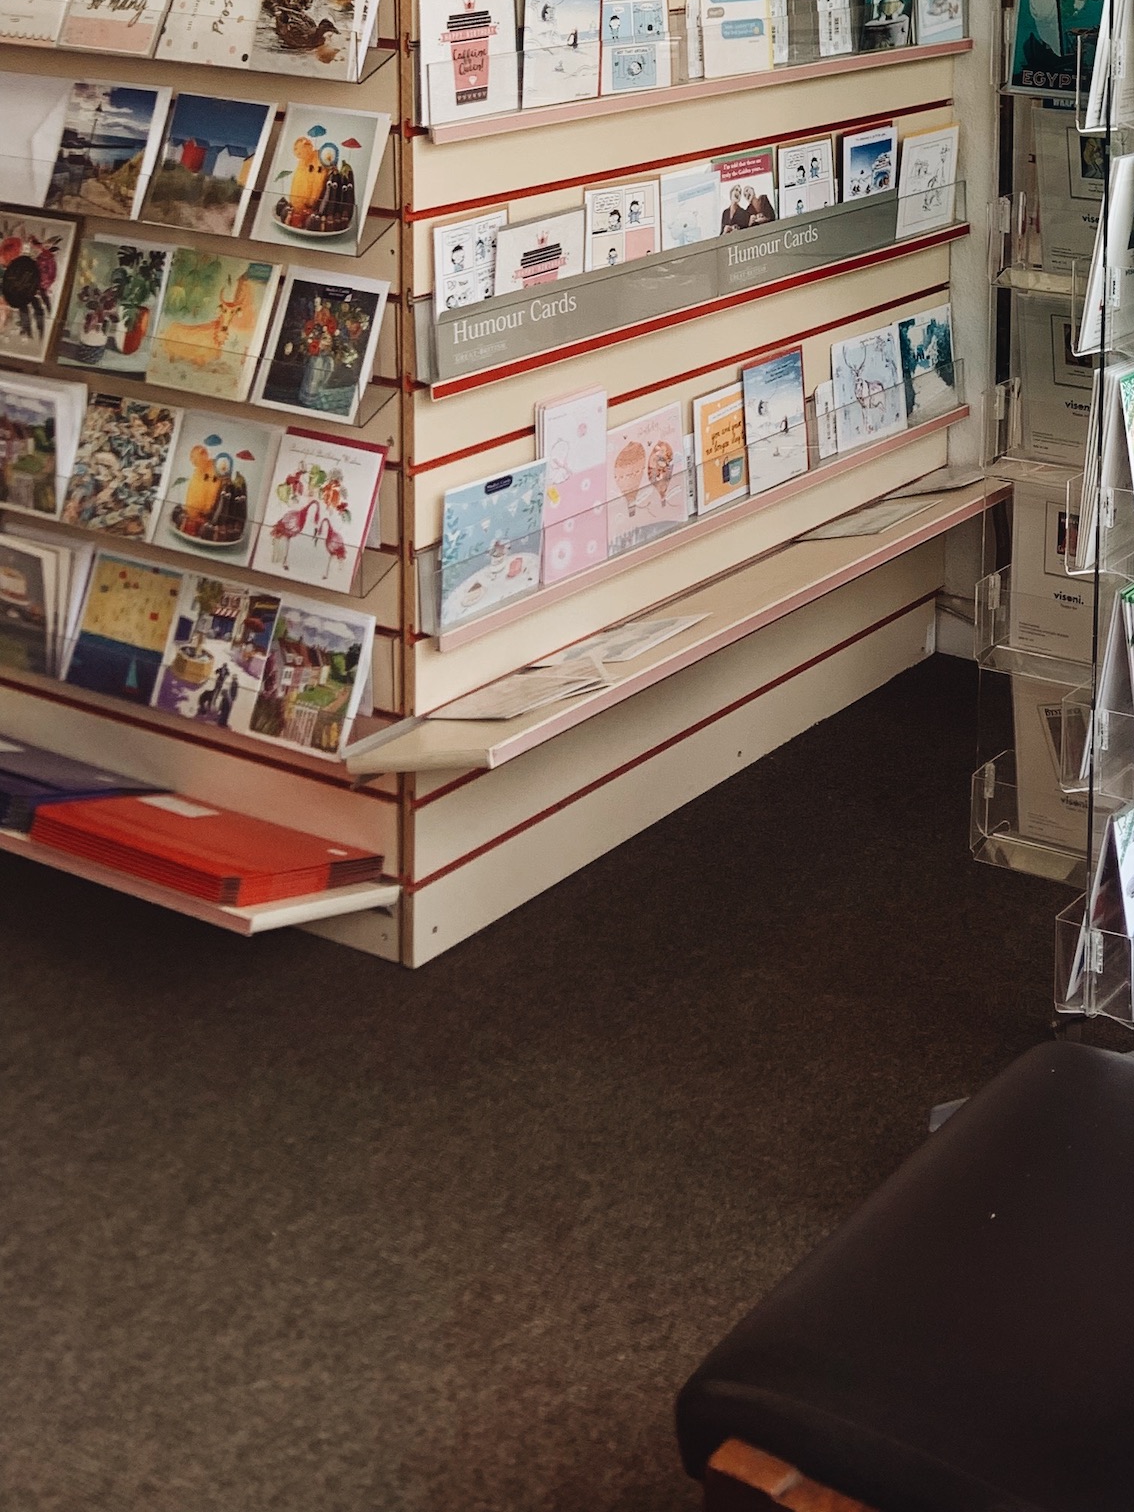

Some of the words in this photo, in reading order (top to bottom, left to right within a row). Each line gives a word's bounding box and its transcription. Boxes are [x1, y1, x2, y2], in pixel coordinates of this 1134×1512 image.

[728, 239, 781, 266] Humour
[784, 225, 818, 248] Cards
[453, 310, 525, 345] Humour
[530, 292, 577, 322] Cards
